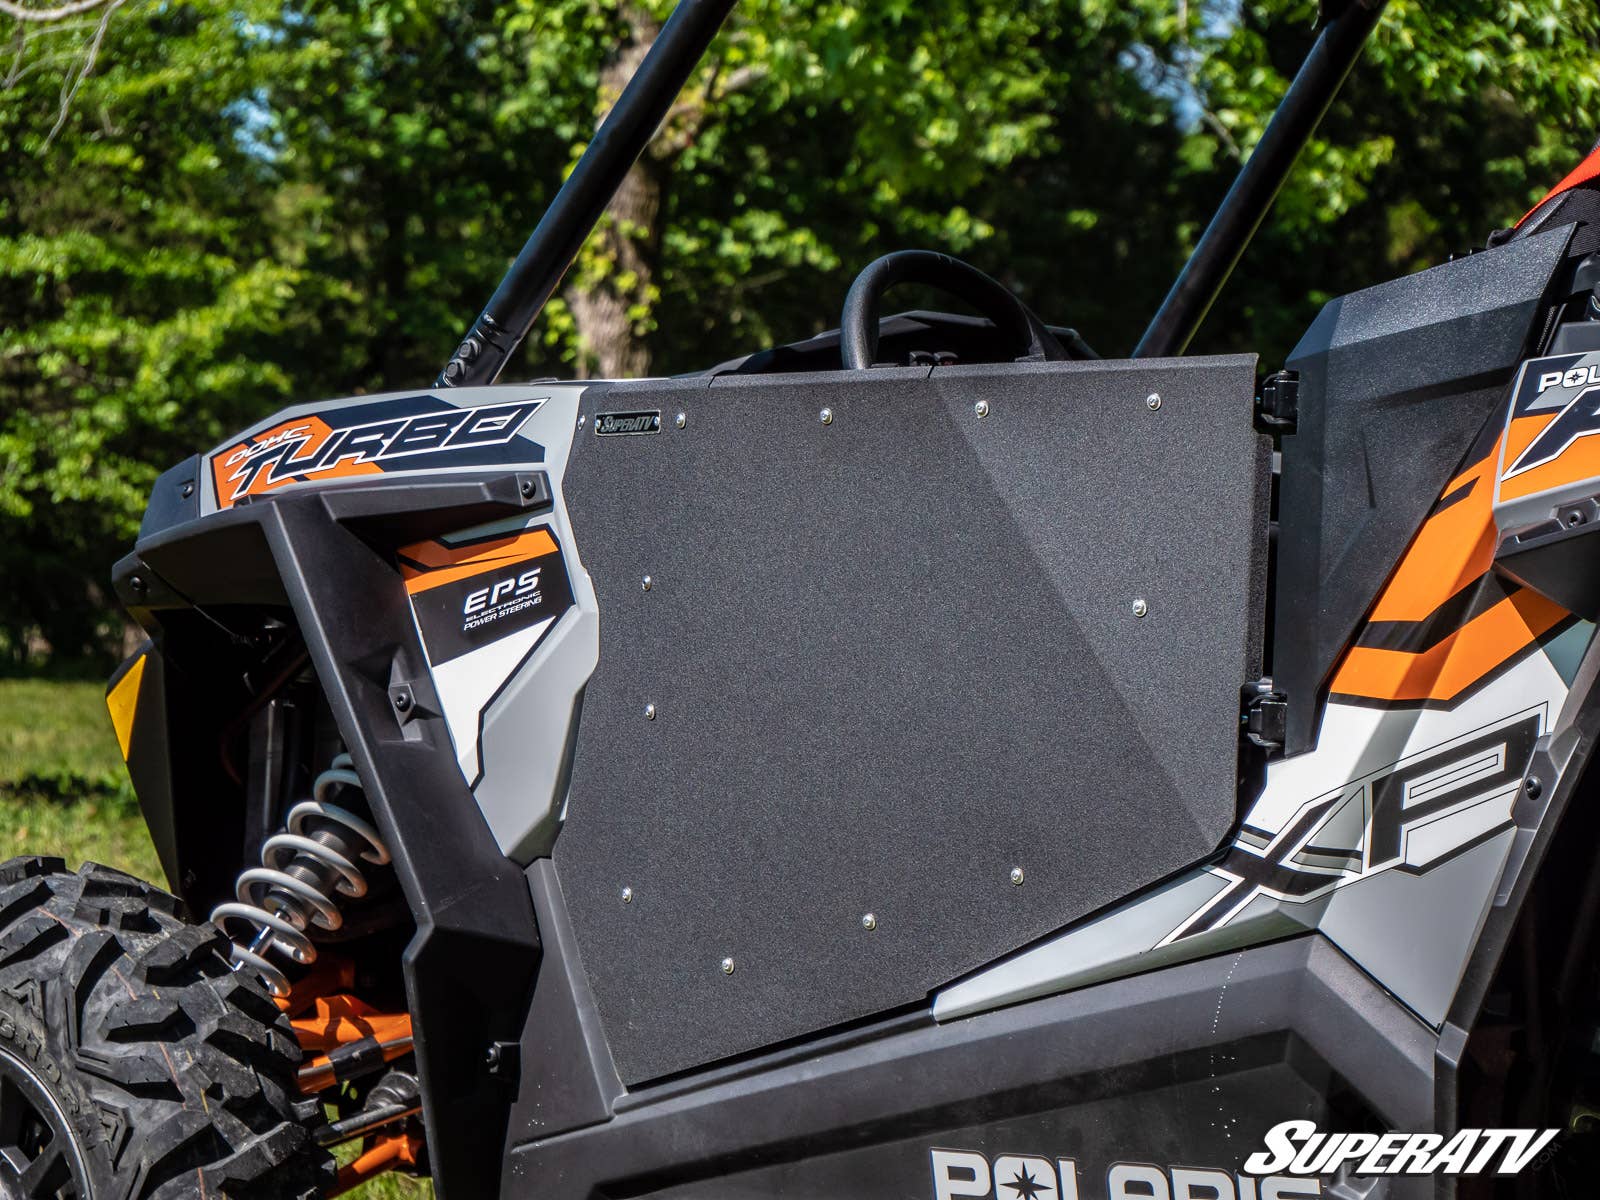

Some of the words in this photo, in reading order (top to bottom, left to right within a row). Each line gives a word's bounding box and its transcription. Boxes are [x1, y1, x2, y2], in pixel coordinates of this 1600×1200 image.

[227, 397, 551, 500] TURBO
[464, 567, 541, 615] EPS
[465, 590, 541, 622] ELECTRONIC
[464, 613, 498, 631] POWER
[498, 596, 542, 618] STEERING
